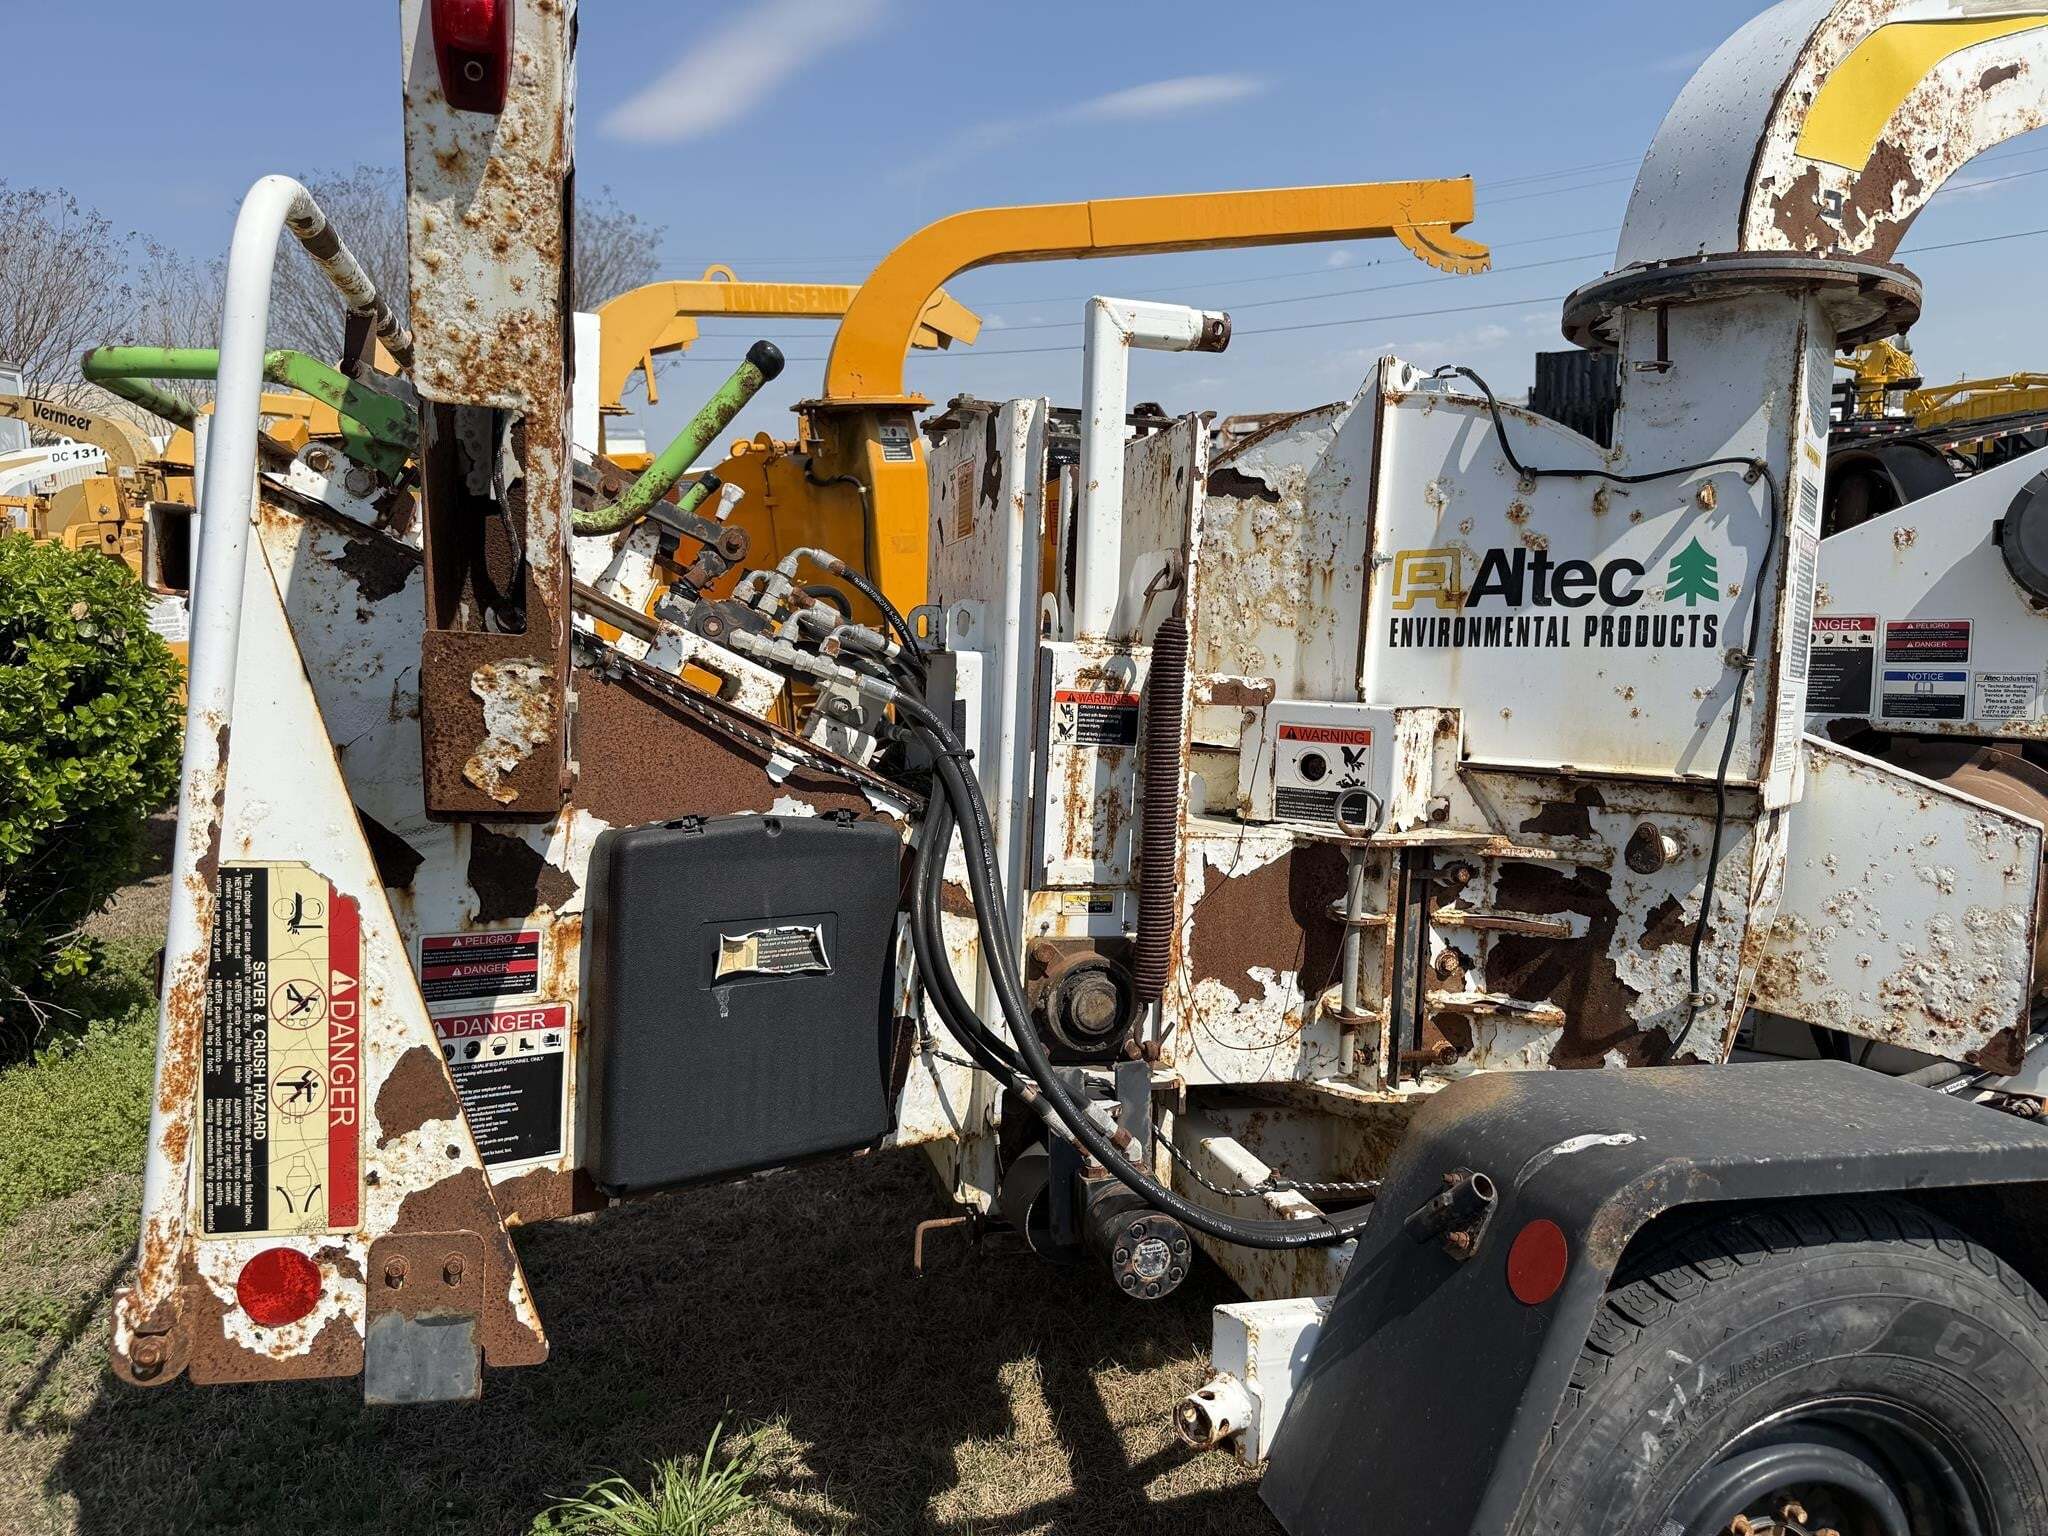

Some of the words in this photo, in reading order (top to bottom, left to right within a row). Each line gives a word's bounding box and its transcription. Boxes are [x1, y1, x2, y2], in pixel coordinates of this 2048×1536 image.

[32, 402, 92, 431] Vermeer
[52, 452, 69, 463] DC
[1464, 548, 1645, 608] Altec
[1390, 616, 1570, 648] ENVIRONMENTAL
[1584, 614, 1718, 648] PRODUCTS
[1906, 672, 1944, 680] NOTICE
[1077, 694, 1129, 705] WARNING
[1299, 728, 1364, 743] WARNING
[225, 878, 233, 898] rollers
[234, 876, 242, 900] NEVER
[244, 874, 253, 888] This
[234, 903, 242, 922] reach
[244, 891, 253, 916] chipper
[244, 918, 253, 929] will
[225, 932, 233, 955] blades.
[244, 932, 252, 951] cause
[465, 935, 512, 945] PELIGRO
[234, 943, 242, 959] feed
[244, 954, 253, 973] death
[464, 963, 510, 975] DANGER
[244, 976, 252, 984] or
[253, 961, 265, 1007] SEVER
[234, 979, 242, 1003] NEVER
[244, 986, 253, 1010] serious
[214, 1007, 222, 1023] push
[234, 1006, 242, 1025] climb
[244, 1013, 253, 1033] injury.
[253, 1014, 265, 1023] &
[454, 1012, 546, 1036] DANGER
[206, 1035, 214, 1046] leg
[244, 1038, 253, 1061] Always
[234, 1047, 242, 1062] feed
[253, 1029, 265, 1076] CRUSH
[499, 1058, 530, 1066] PERSONNEL
[206, 1058, 214, 1074] foot.
[234, 1065, 242, 1083] table
[245, 1064, 253, 1084] follow
[330, 1001, 355, 1128] DANGER
[206, 1099, 214, 1122] cutting
[245, 1097, 253, 1135] instructions
[254, 1083, 265, 1140] HAZARD
[245, 1138, 253, 1150] and
[224, 1154, 233, 1169] right
[244, 1153, 253, 1181] warnings
[206, 1166, 214, 1180] fully
[215, 1182, 223, 1206] cutting
[245, 1184, 253, 1202] listed
[245, 1205, 253, 1226] below.
